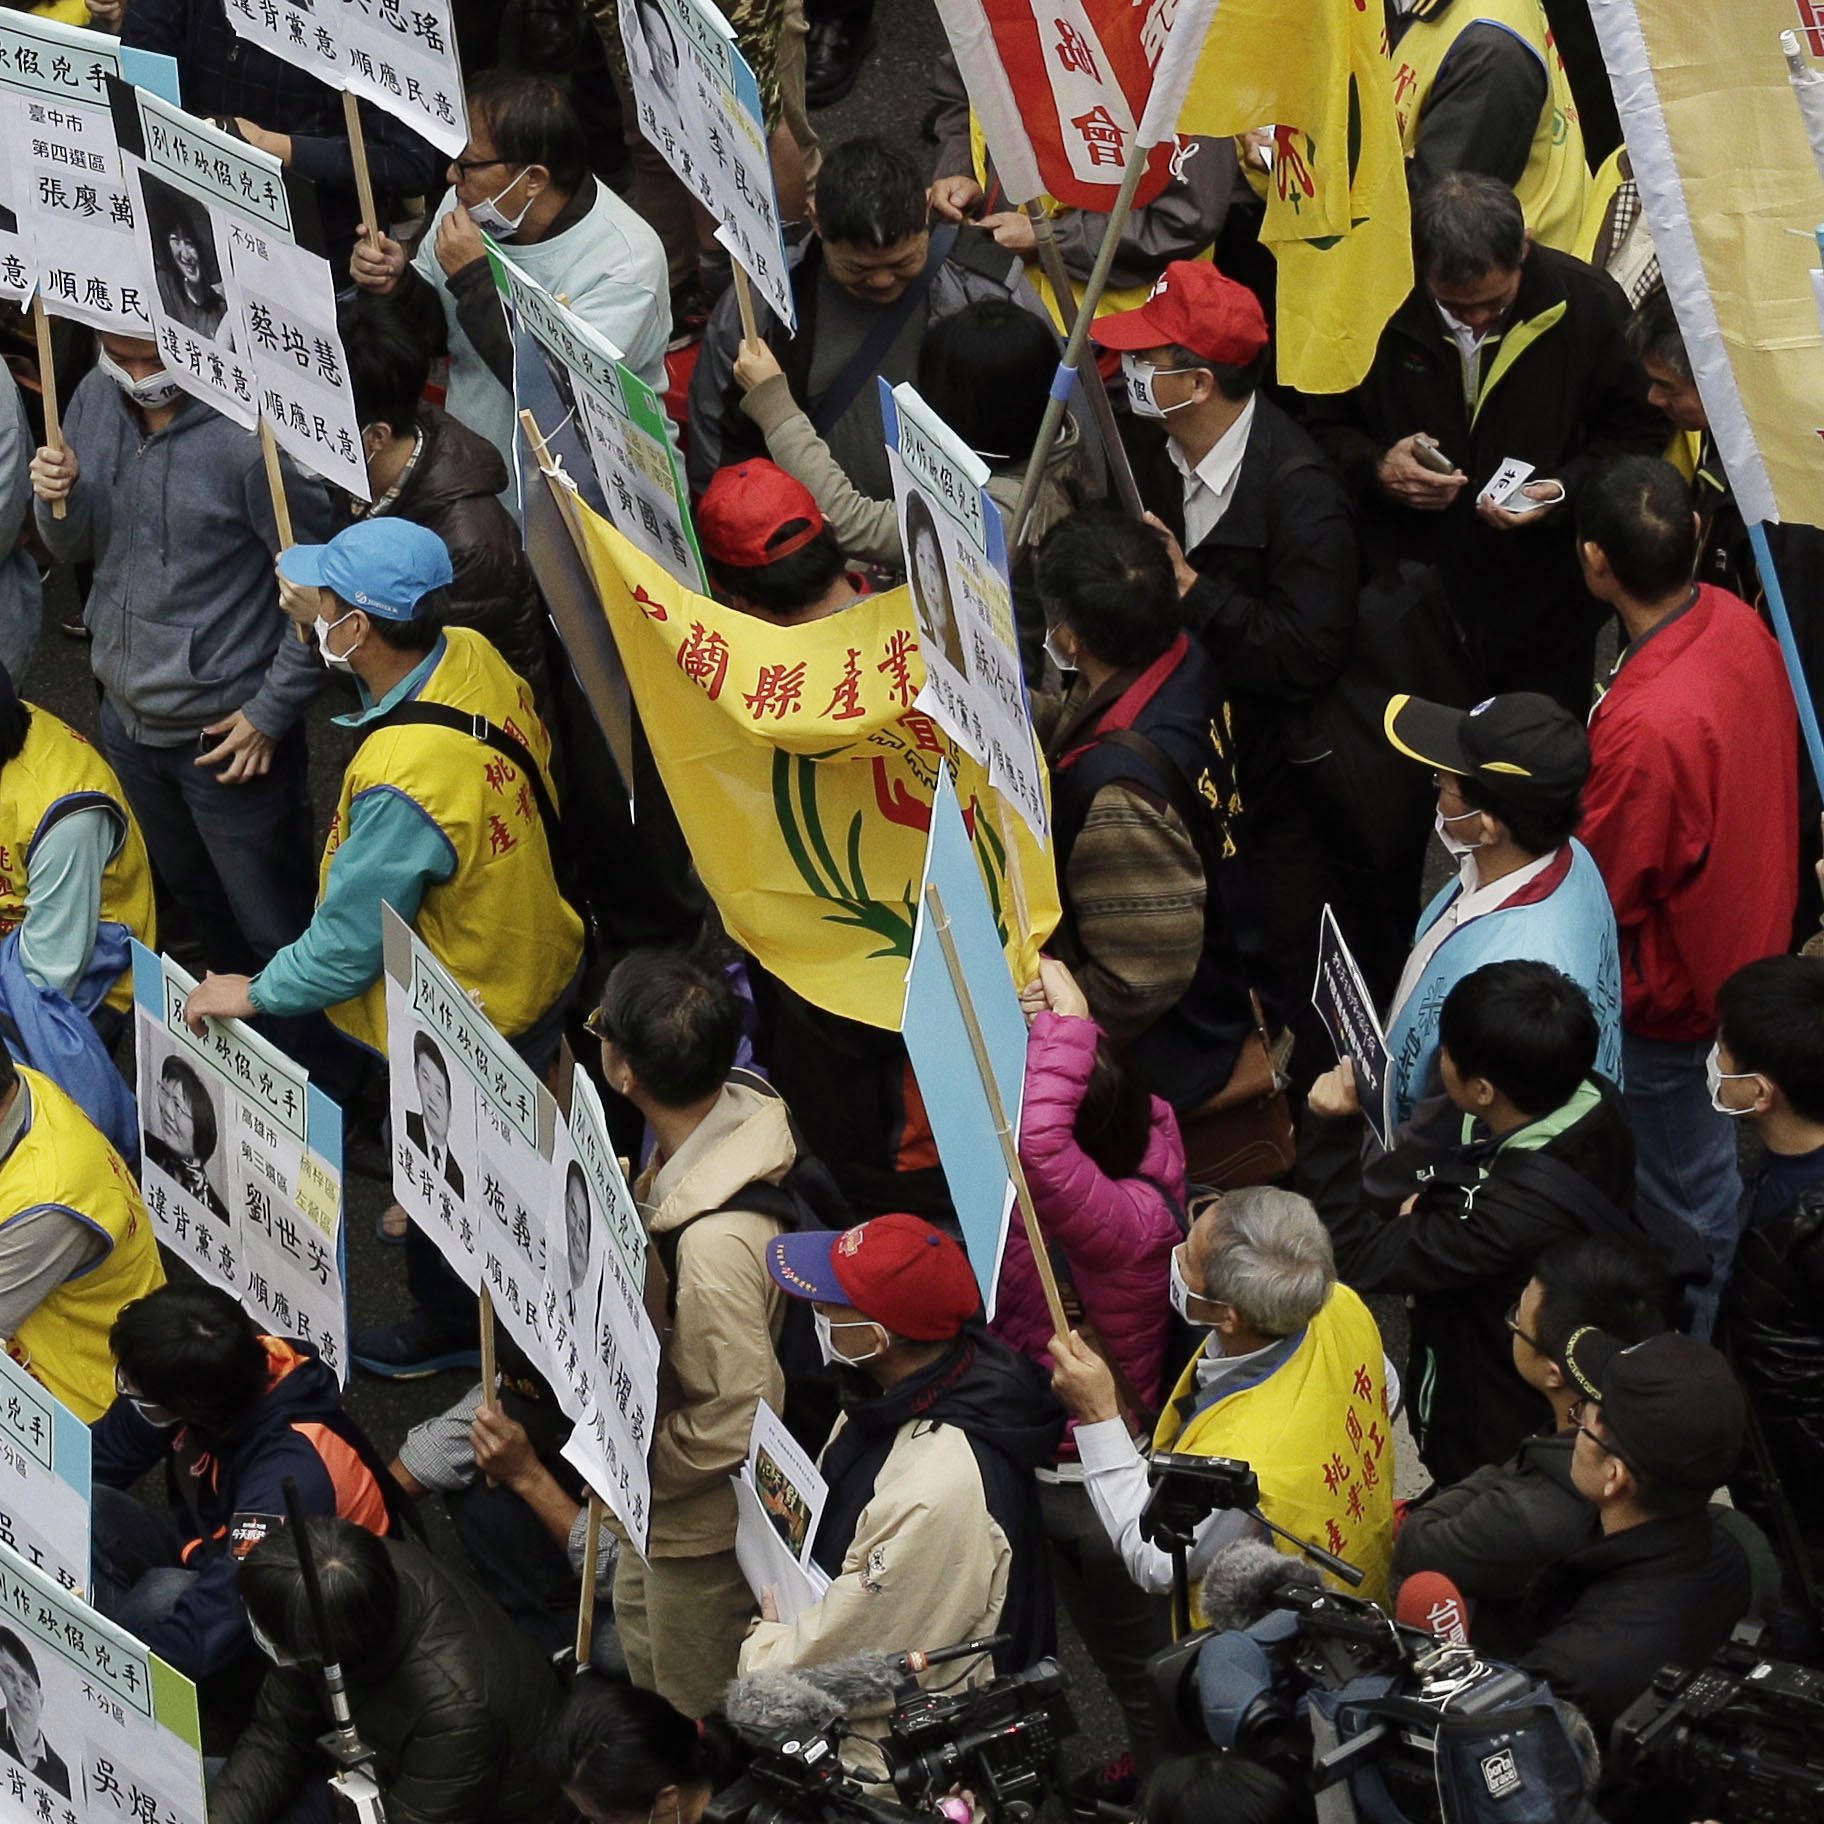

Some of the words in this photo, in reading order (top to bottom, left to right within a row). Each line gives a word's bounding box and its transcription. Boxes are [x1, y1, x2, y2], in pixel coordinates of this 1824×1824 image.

[251, 302, 342, 387] 蔡培慧
[263, 389, 356, 465] 順應民意
[420, 978, 533, 1121] 別作砍假兇手
[149, 1186, 237, 1281] 違背黨意
[246, 1186, 331, 1285] 劉世芳
